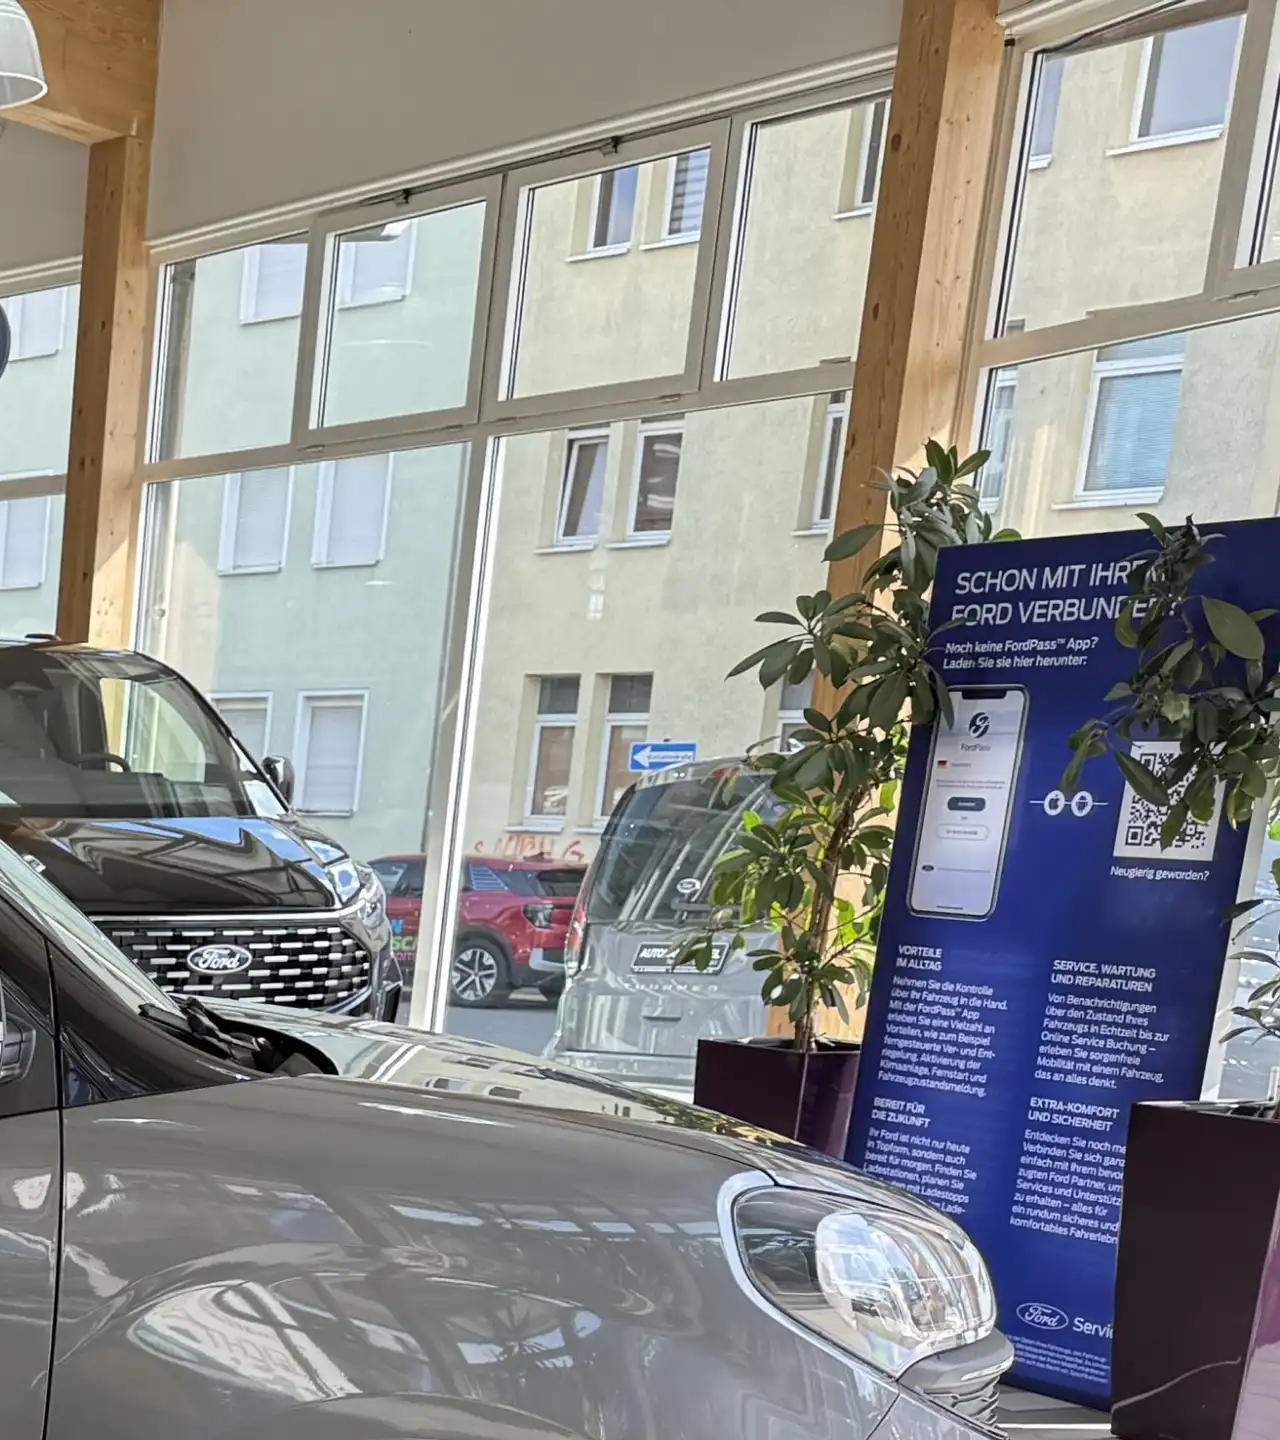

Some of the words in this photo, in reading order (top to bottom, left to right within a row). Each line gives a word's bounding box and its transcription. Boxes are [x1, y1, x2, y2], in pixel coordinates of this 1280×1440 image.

[955, 568, 1037, 595] SCHON
[1042, 564, 1086, 589] MIT
[951, 602, 1012, 626] FORD
[945, 642, 973, 654] Noch
[975, 641, 1003, 652] keine
[1067, 637, 1099, 652] App?
[943, 657, 976, 669] Laden
[978, 657, 993, 668] Sie
[996, 657, 1012, 668] sie
[1014, 656, 1033, 667] hier
[1110, 865, 1154, 879] Neugierig
[1155, 869, 1210, 881] geworden?
[898, 944, 942, 958] VORTEILE
[896, 958, 908, 968] IM
[908, 959, 942, 971] ALLTAG
[1053, 959, 1099, 974] SERVICE,
[1100, 963, 1156, 979] WARTUNG
[893, 976, 926, 989] Nehmen
[928, 979, 941, 990] Sie
[941, 980, 954, 992] die
[955, 983, 993, 995] Kontrolle
[1050, 973, 1074, 985] UND
[1074, 975, 1153, 992] REPARATUREN
[910, 989, 921, 999] Ihr
[921, 991, 959, 1006] Fahrzeug
[959, 995, 968, 1005] in
[968, 996, 982, 1006] die
[983, 998, 1008, 1010] Hand.
[1048, 993, 1065, 1003] Von
[1066, 995, 1157, 1014] Benachrichtigungen
[889, 1001, 902, 1010] Mit
[902, 1002, 917, 1012] der
[961, 1008, 980, 1020] App
[1066, 1008, 1084, 1019] den
[1085, 1010, 1124, 1023] Zustand
[1125, 1014, 1149, 1026] Ihres
[887, 1012, 917, 1024] erleben
[918, 1016, 930, 1026] Sie
[932, 1017, 949, 1028] eine
[950, 1020, 982, 1032] Vielzahl
[983, 1024, 995, 1034] an
[1043, 1018, 1089, 1034] Fahrzeugs
[1090, 1022, 1099, 1033] in
[1100, 1024, 1137, 1039] Echtzeit
[1138, 1030, 1153, 1041] bis
[1154, 1033, 1170, 1042] zur
[923, 1028, 938, 1039] wie
[939, 1031, 956, 1041] zum
[958, 1032, 991, 1046] Beispiel
[1041, 1031, 1070, 1043] Online
[1071, 1034, 1105, 1048] Service
[1106, 1038, 1148, 1054] Buchung
[920, 1053, 966, 1069] Aktivierung
[966, 1058, 981, 1070] der
[942, 1044, 959, 1053] Ver-
[960, 1046, 976, 1056] und
[977, 1048, 995, 1059] Ent-
[1038, 1044, 1072, 1057] erleben
[1073, 1048, 1089, 1059] Sie
[1089, 1050, 1141, 1066] sorgenfreie
[931, 1066, 969, 1081] Fernstart
[969, 1073, 987, 1083] und
[1034, 1069, 1051, 1080] das
[1052, 1072, 1065, 1082] an
[1065, 1072, 1087, 1085] alles
[1088, 1075, 1117, 1089] denkt.
[1075, 1062, 1091, 1073] mit
[1092, 1064, 1120, 1076] einem
[874, 1097, 905, 1110] BEREIT
[906, 1101, 925, 1114] FÜR
[1030, 1096, 1120, 1119] EXTRA-KOMFORT
[871, 1109, 887, 1120] DIE
[887, 1111, 931, 1128] ZUKUNFT
[1028, 1110, 1050, 1122] UND
[1051, 1113, 1113, 1132] SICHERHEIT
[880, 1129, 899, 1140] Ford
[900, 1132, 909, 1143] ist
[910, 1134, 930, 1147] nicht
[931, 1140, 945, 1149] nur
[946, 1141, 971, 1154] heute
[1024, 1129, 1070, 1145] Entdecken
[1072, 1136, 1087, 1148] Sie
[1087, 1138, 1111, 1152] noch
[866, 1138, 874, 1149] in
[911, 1148, 944, 1161] sondern
[945, 1154, 965, 1165] auch
[1022, 1142, 1067, 1157] Verbinden
[1068, 1149, 1082, 1160] Sie
[1083, 1152, 1102, 1163] sich
[865, 1151, 888, 1163] bereit
[889, 1154, 900, 1164] für
[935, 1163, 962, 1177] Finden
[963, 1169, 977, 1180] Sie
[1020, 1155, 1053, 1168] einfach
[1053, 1160, 1069, 1170] mit
[1070, 1162, 1097, 1175] Ihrem
[921, 1175, 950, 1187] planen
[951, 1179, 964, 1190] Sie
[1049, 1171, 1070, 1184] Ford
[921, 1186, 969, 1203] Ladestopps
[1016, 1179, 1053, 1194] Services
[1054, 1187, 1072, 1197] und
[1013, 1193, 1024, 1201] zu
[1025, 1194, 1062, 1208] erhalten
[1071, 1202, 1093, 1214] alles
[1009, 1216, 1068, 1236] komfortables
[1011, 1204, 1025, 1214] ein
[1026, 1207, 1061, 1221] rundum
[1061, 1213, 1099, 1228] sicheres
[1023, 1304, 1061, 1328] Ford
